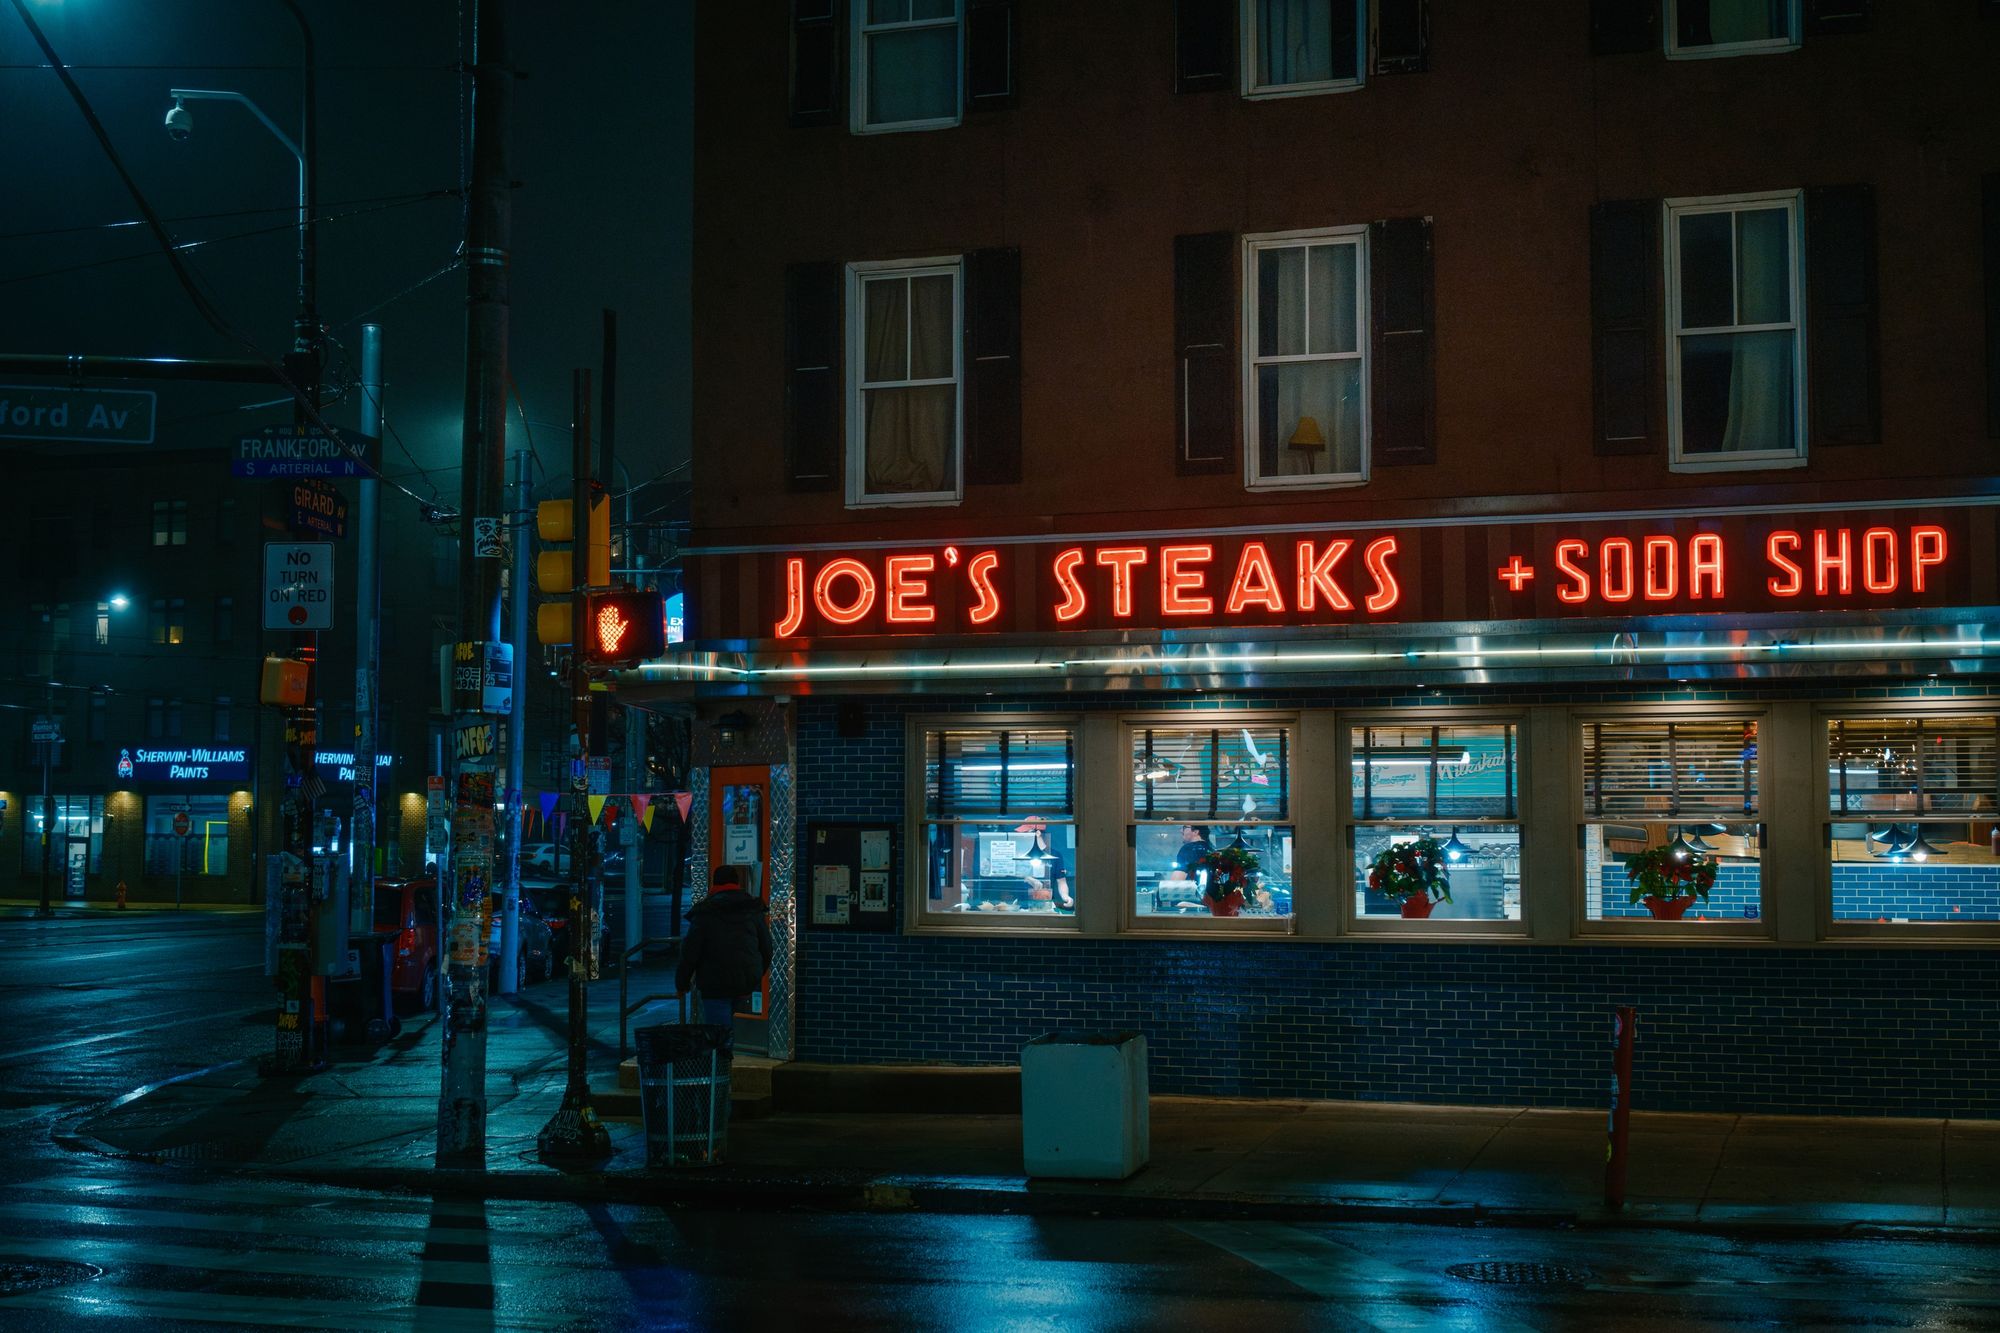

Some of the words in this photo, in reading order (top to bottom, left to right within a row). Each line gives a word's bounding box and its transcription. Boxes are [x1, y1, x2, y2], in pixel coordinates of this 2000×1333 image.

[87, 403, 128, 430] Av
[241, 438, 341, 458] FRANKFORD
[350, 444, 366, 457] AV
[246, 462, 255, 475] S
[270, 463, 332, 474] ARTERIAL
[345, 461, 354, 474] N
[294, 486, 334, 516] GIRARD
[287, 552, 309, 565] NO
[280, 570, 317, 583] TURN
[775, 546, 999, 638] JOE'S
[1054, 536, 1399, 621] STEAKS
[1556, 532, 1724, 603] SODA
[1767, 526, 1947, 595] SHOP
[270, 589, 289, 602] ON
[297, 589, 326, 602] RED
[485, 674, 495, 686] 25
[136, 749, 245, 763] SHERWIN-WILLIAMS
[170, 765, 208, 779] PAINTS
